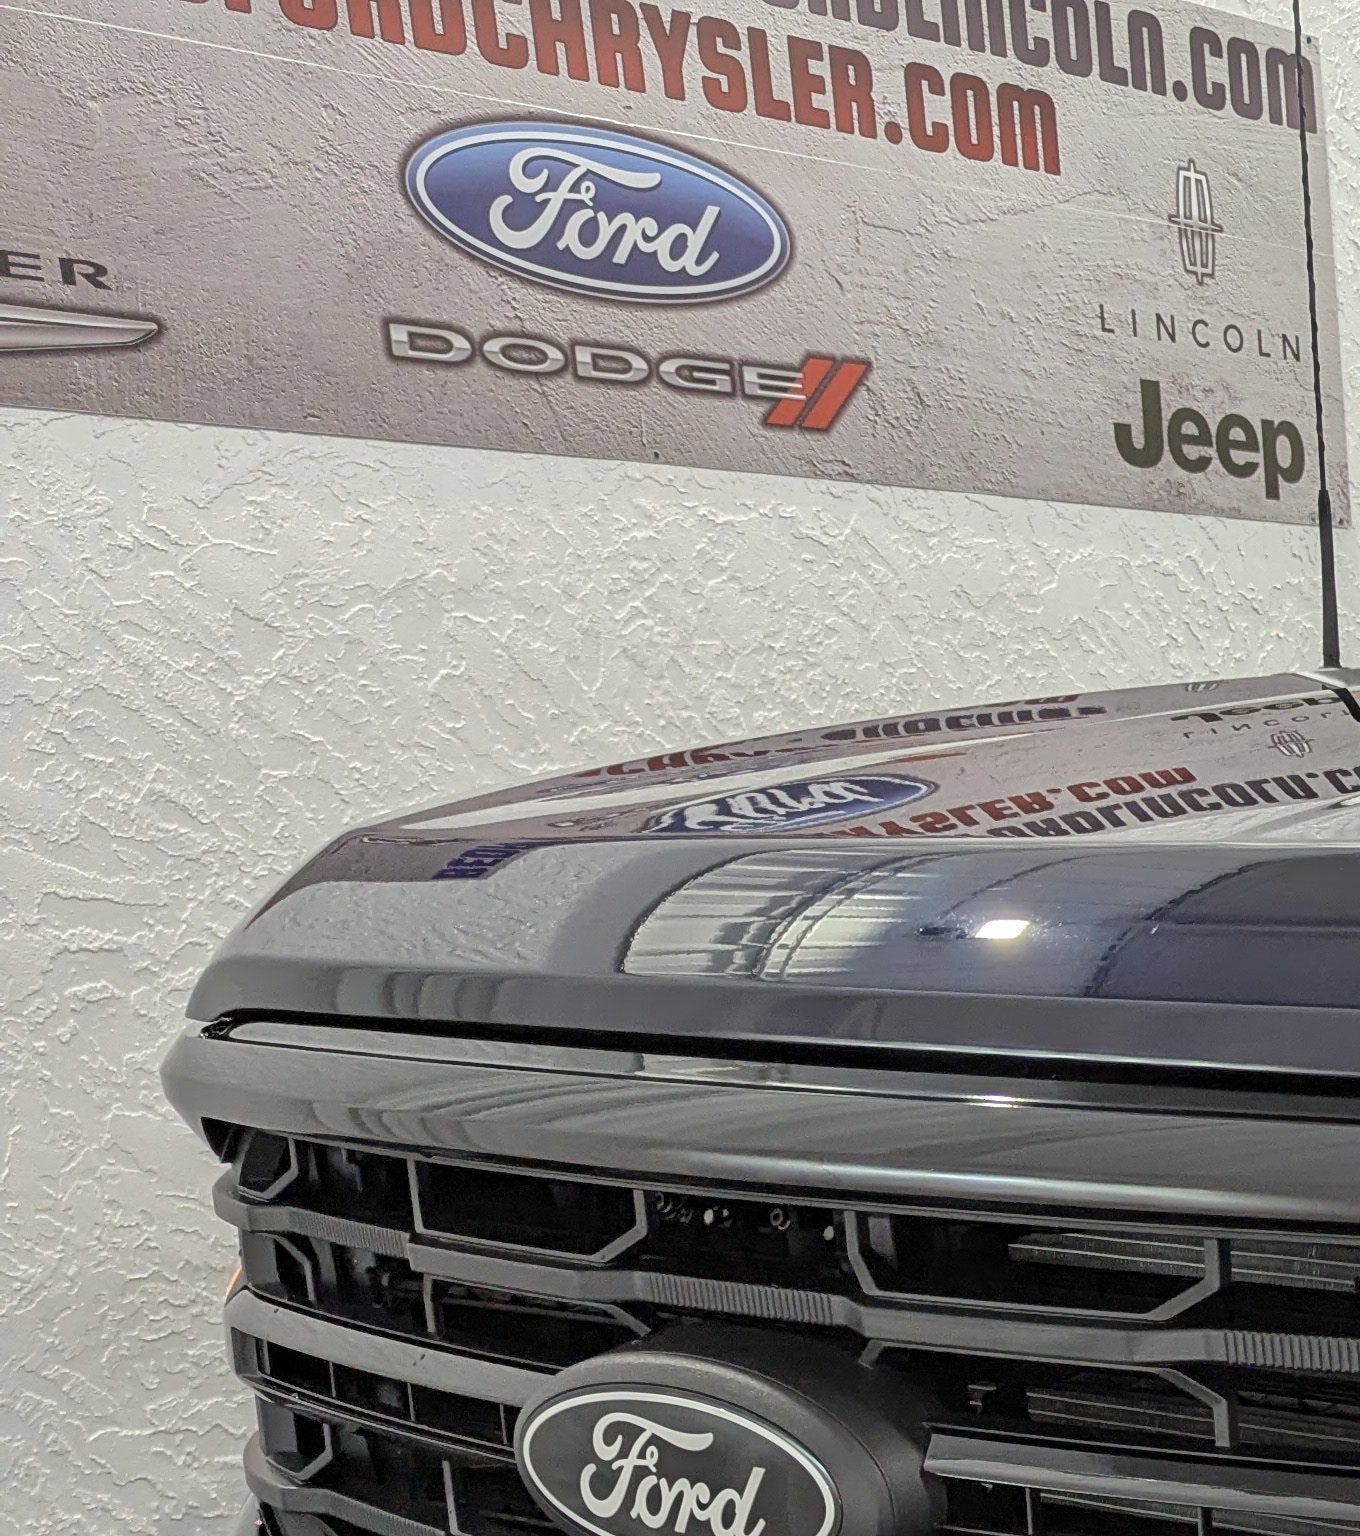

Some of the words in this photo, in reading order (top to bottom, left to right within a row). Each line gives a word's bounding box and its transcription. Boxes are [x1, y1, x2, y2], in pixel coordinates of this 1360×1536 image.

[489, 146, 721, 277] Ford
[388, 322, 807, 399] DODGE
[1100, 303, 1301, 362] LINCOLN
[1113, 378, 1305, 501] Jeep
